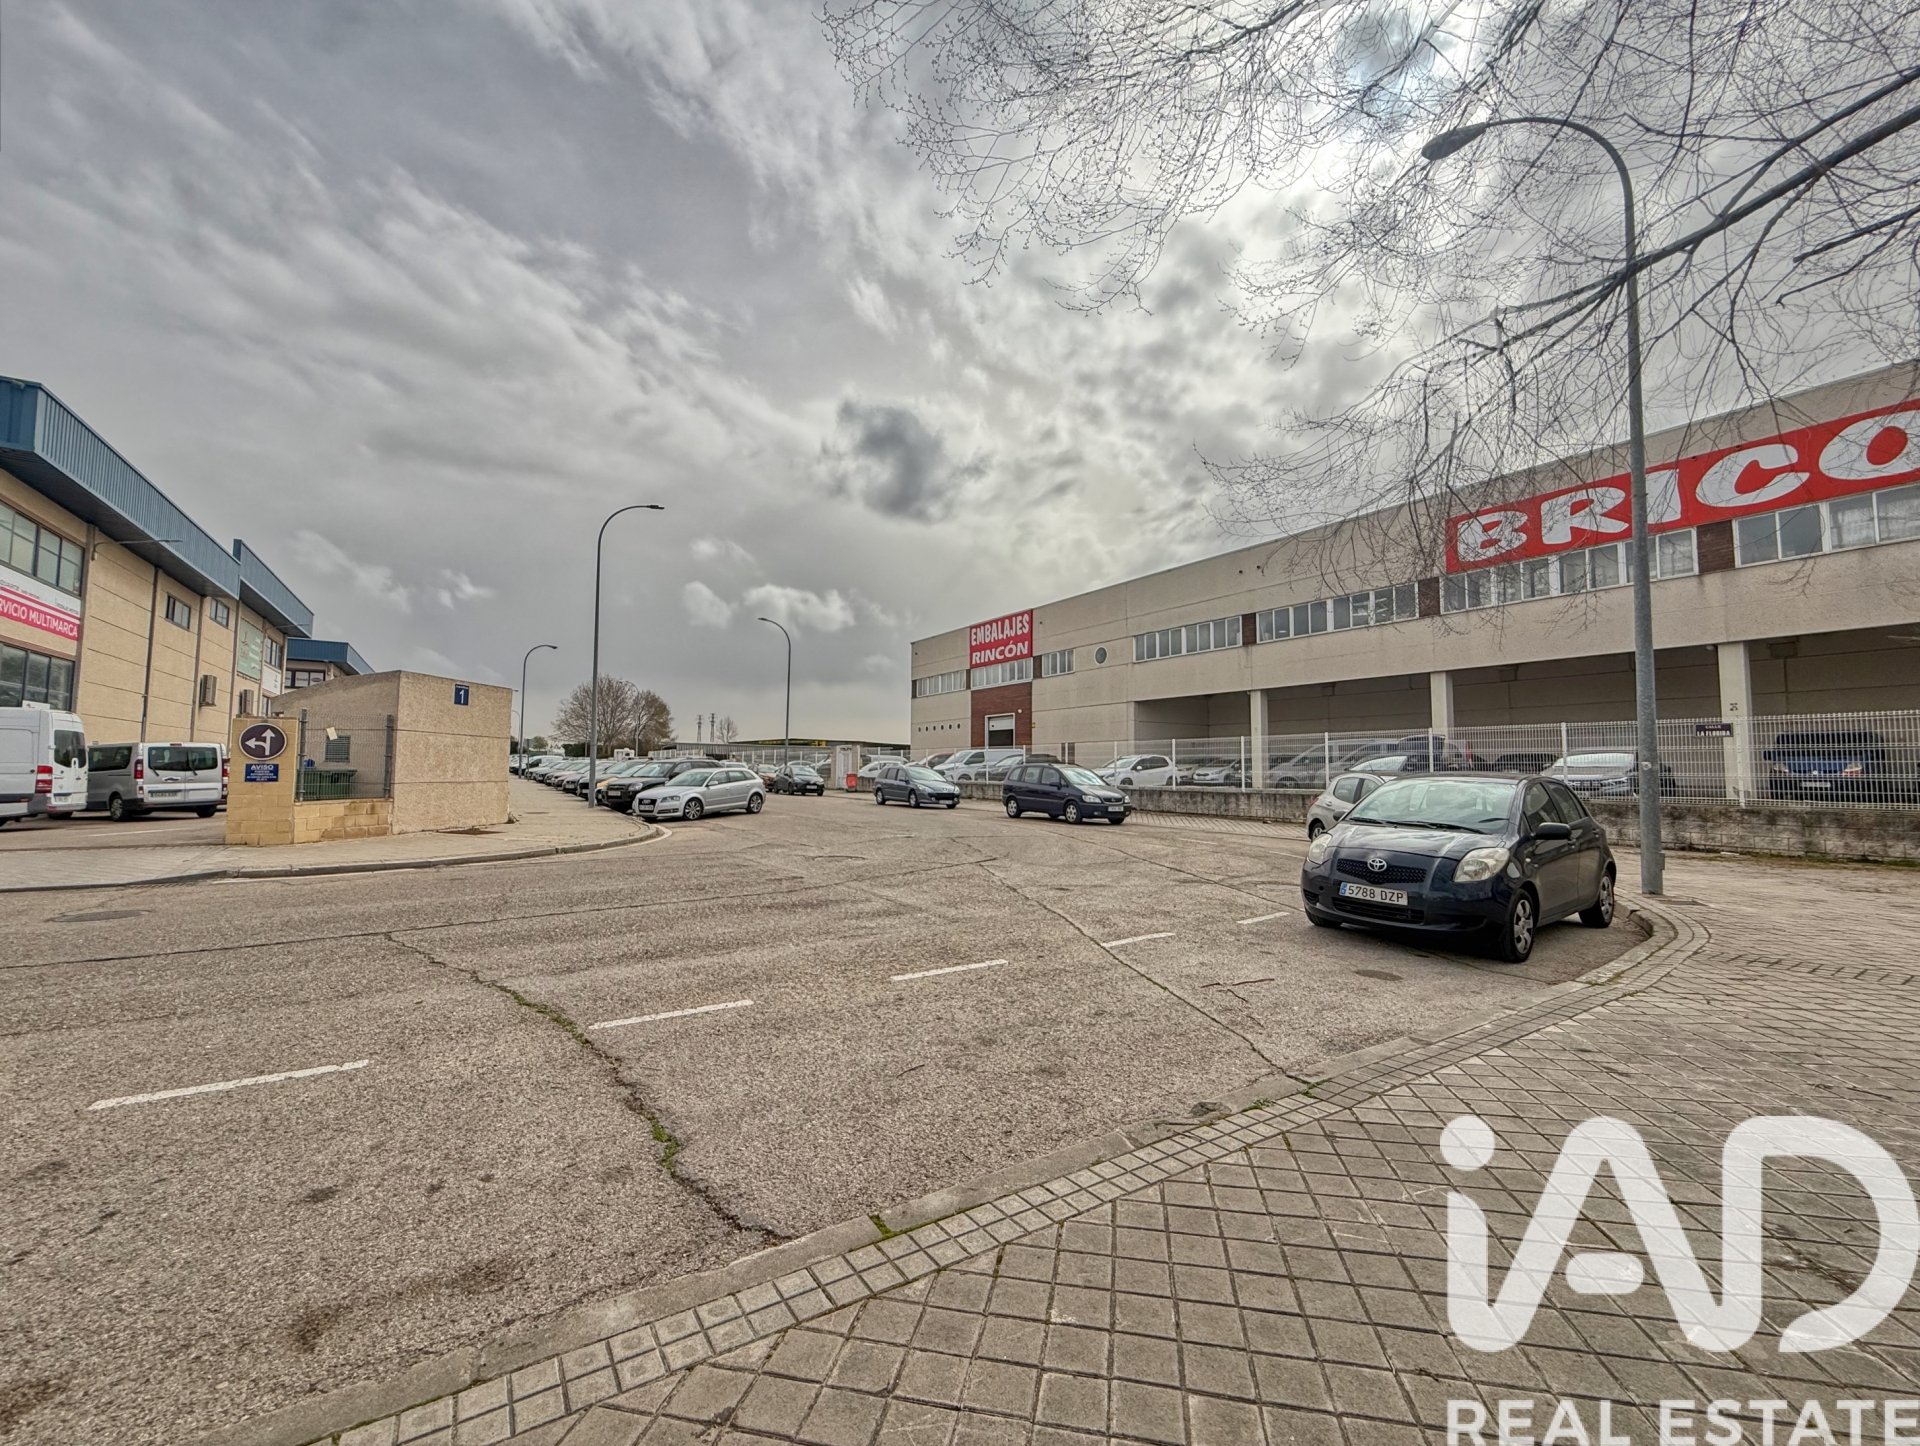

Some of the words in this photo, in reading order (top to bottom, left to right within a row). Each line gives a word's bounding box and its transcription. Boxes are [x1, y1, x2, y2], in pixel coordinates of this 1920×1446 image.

[1457, 410, 1920, 561] BRICO
[29, 609, 78, 637] MULTIMARCA
[971, 613, 1029, 646] EMBALAJES
[972, 640, 1029, 664] RINCÓN
[459, 689, 464, 704] 1
[1348, 885, 1375, 899] 5788
[1380, 890, 1404, 902] DZP
